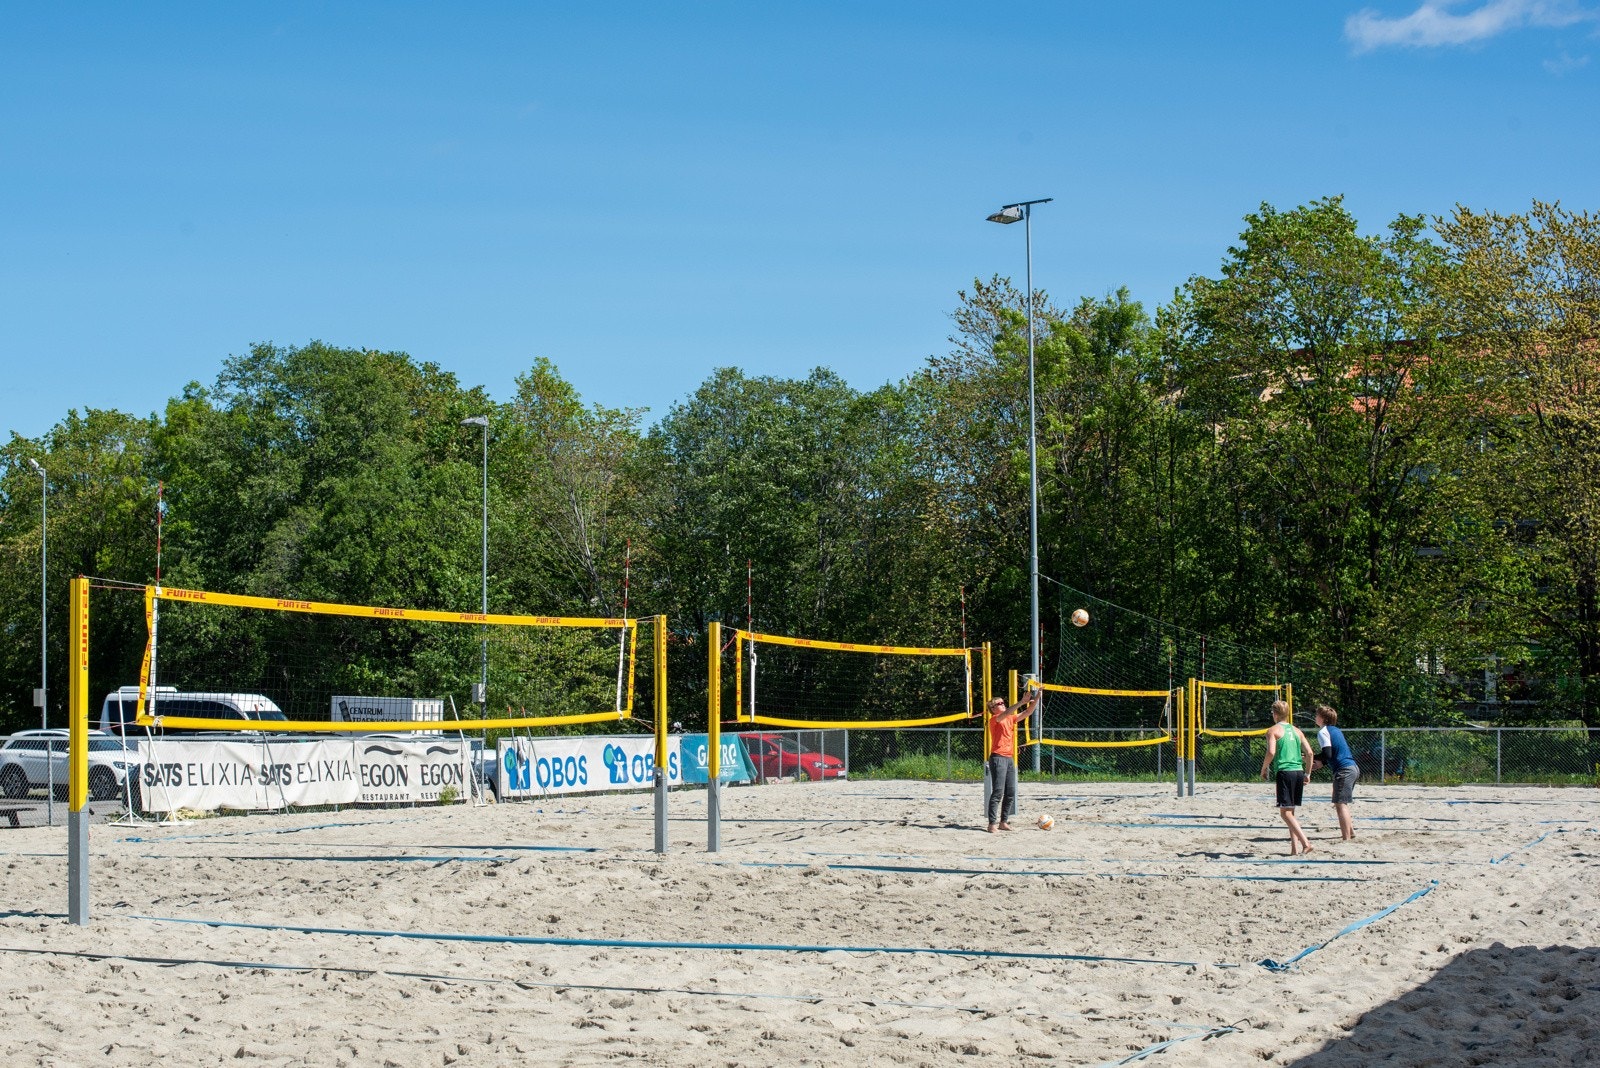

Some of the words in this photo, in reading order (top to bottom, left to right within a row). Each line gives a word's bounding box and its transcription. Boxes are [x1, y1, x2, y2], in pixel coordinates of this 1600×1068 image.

[166, 588, 207, 600] FUNTEC
[277, 600, 312, 609] FUNTEC
[374, 607, 405, 616] FUNTEC
[349, 707, 383, 715] CENTRUM
[144, 763, 182, 787] SATS
[187, 763, 253, 786] ELIXIA
[258, 764, 292, 785] SATS
[297, 760, 352, 783] ELIXIA
[360, 764, 408, 787] EGON
[420, 763, 463, 786] EGON
[536, 755, 587, 788] OBOS
[632, 752, 678, 783] OBS
[362, 793, 409, 801] RESTAURANT
